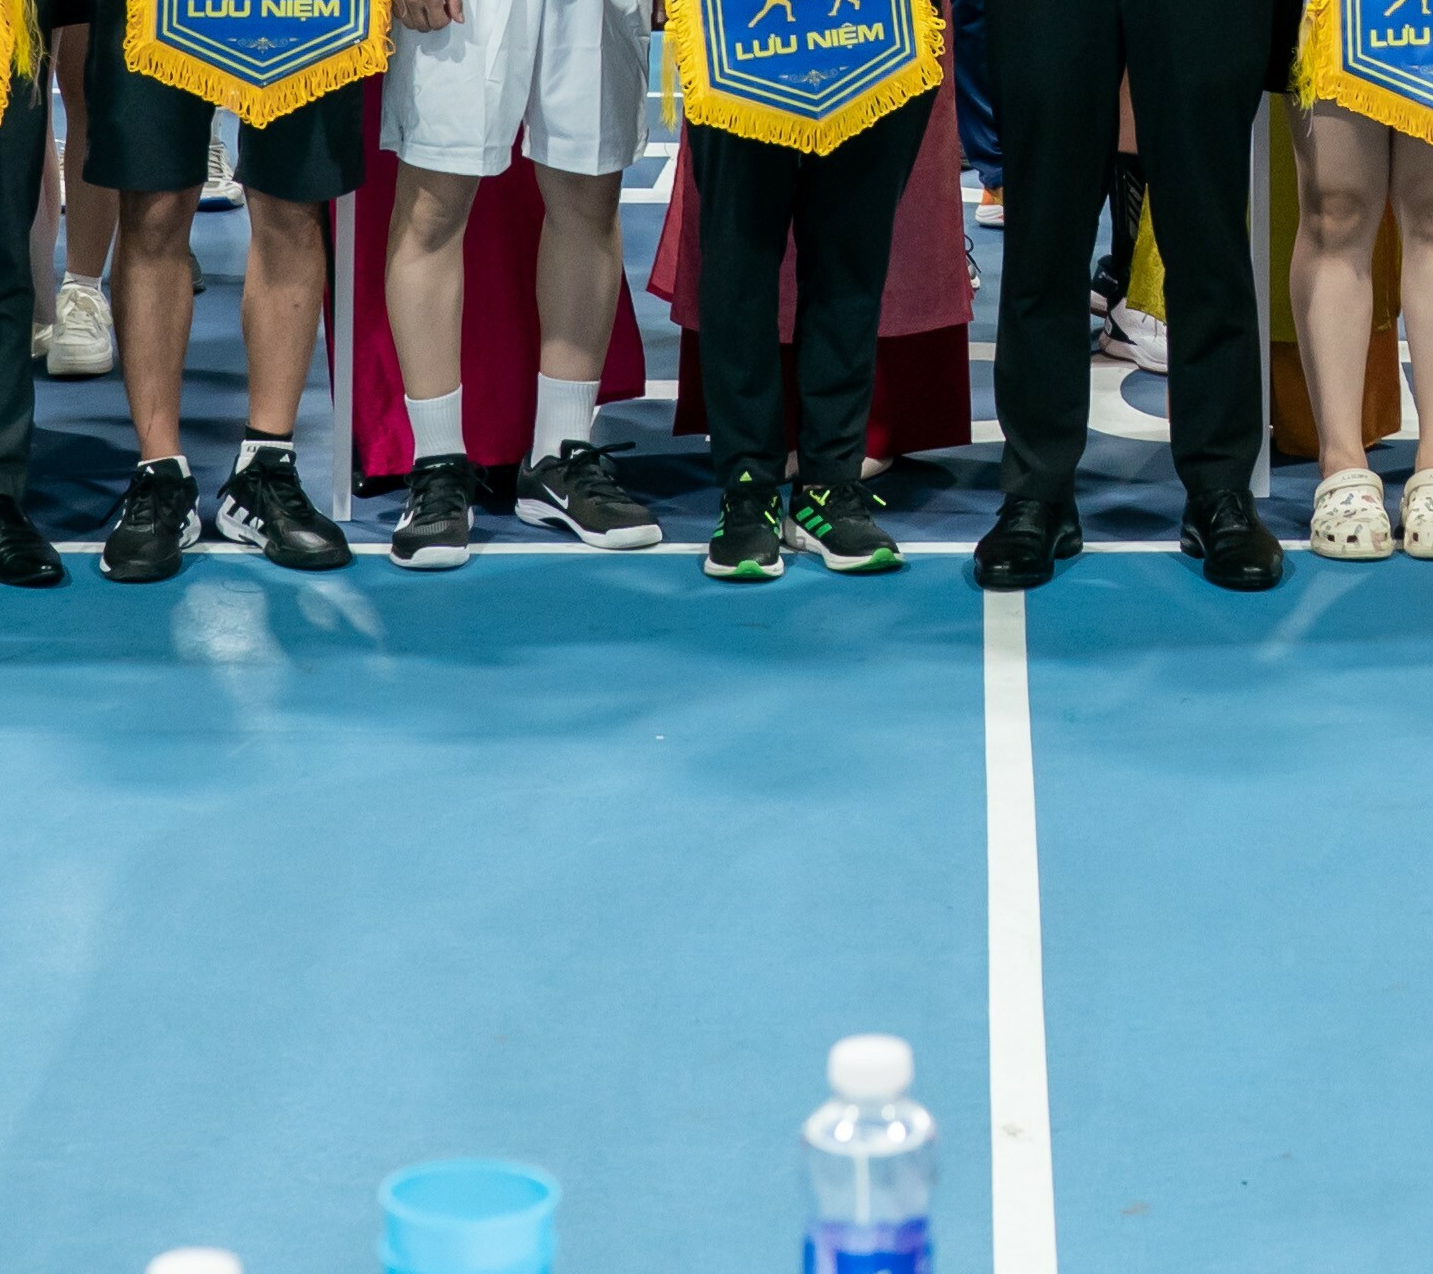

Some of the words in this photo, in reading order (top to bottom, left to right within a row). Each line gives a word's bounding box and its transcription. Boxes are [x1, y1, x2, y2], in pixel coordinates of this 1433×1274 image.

[735, 33, 798, 61] LƯU
[806, 22, 885, 50] NIỆM
[1370, 24, 1431, 47] LƯU
